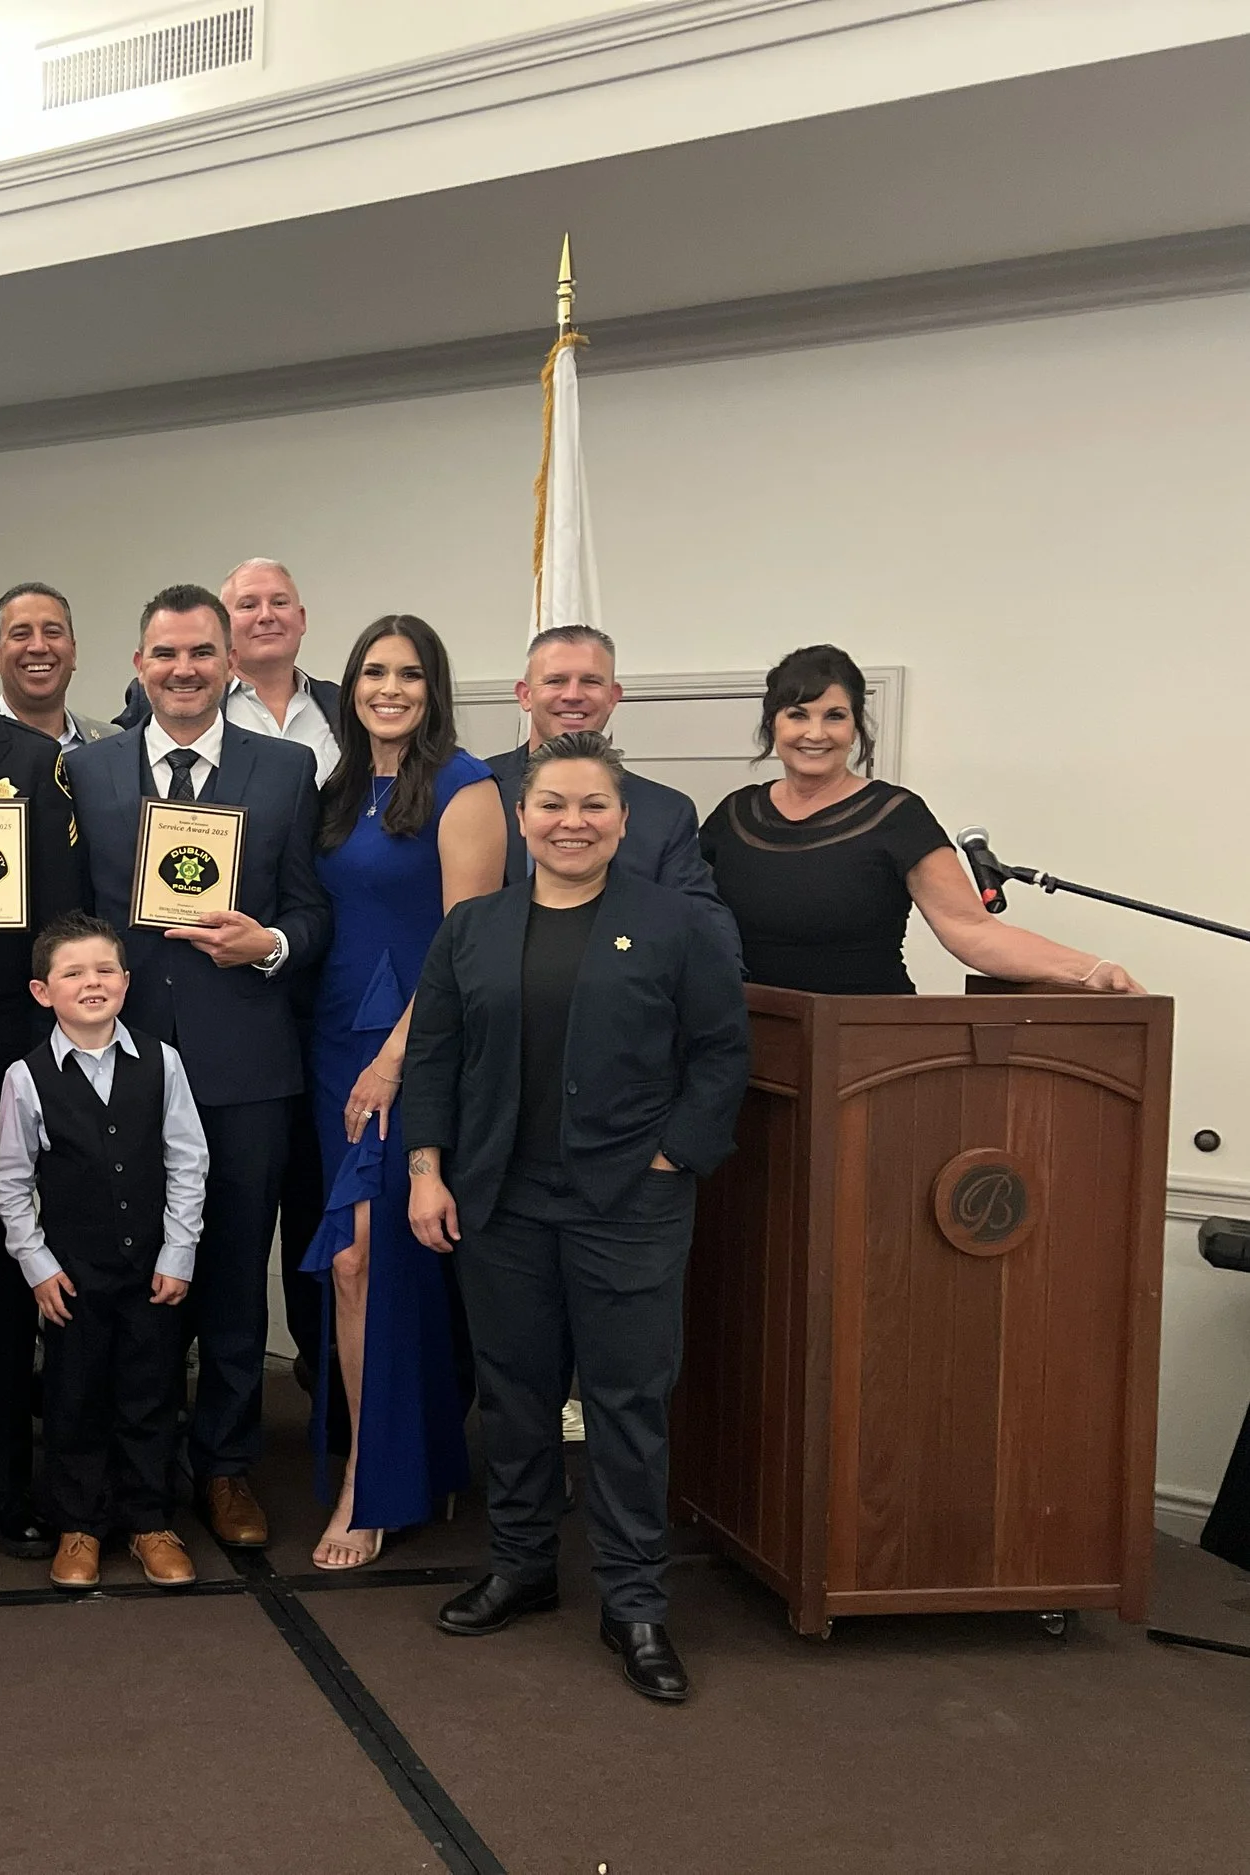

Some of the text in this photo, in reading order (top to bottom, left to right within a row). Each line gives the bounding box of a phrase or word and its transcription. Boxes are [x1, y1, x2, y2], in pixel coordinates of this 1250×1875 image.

[158, 822, 185, 832] Service
[186, 826, 210, 835] Award
[211, 829, 228, 837] 2025
[170, 847, 211, 863] DUBLIN
[172, 884, 202, 892] POLICE
